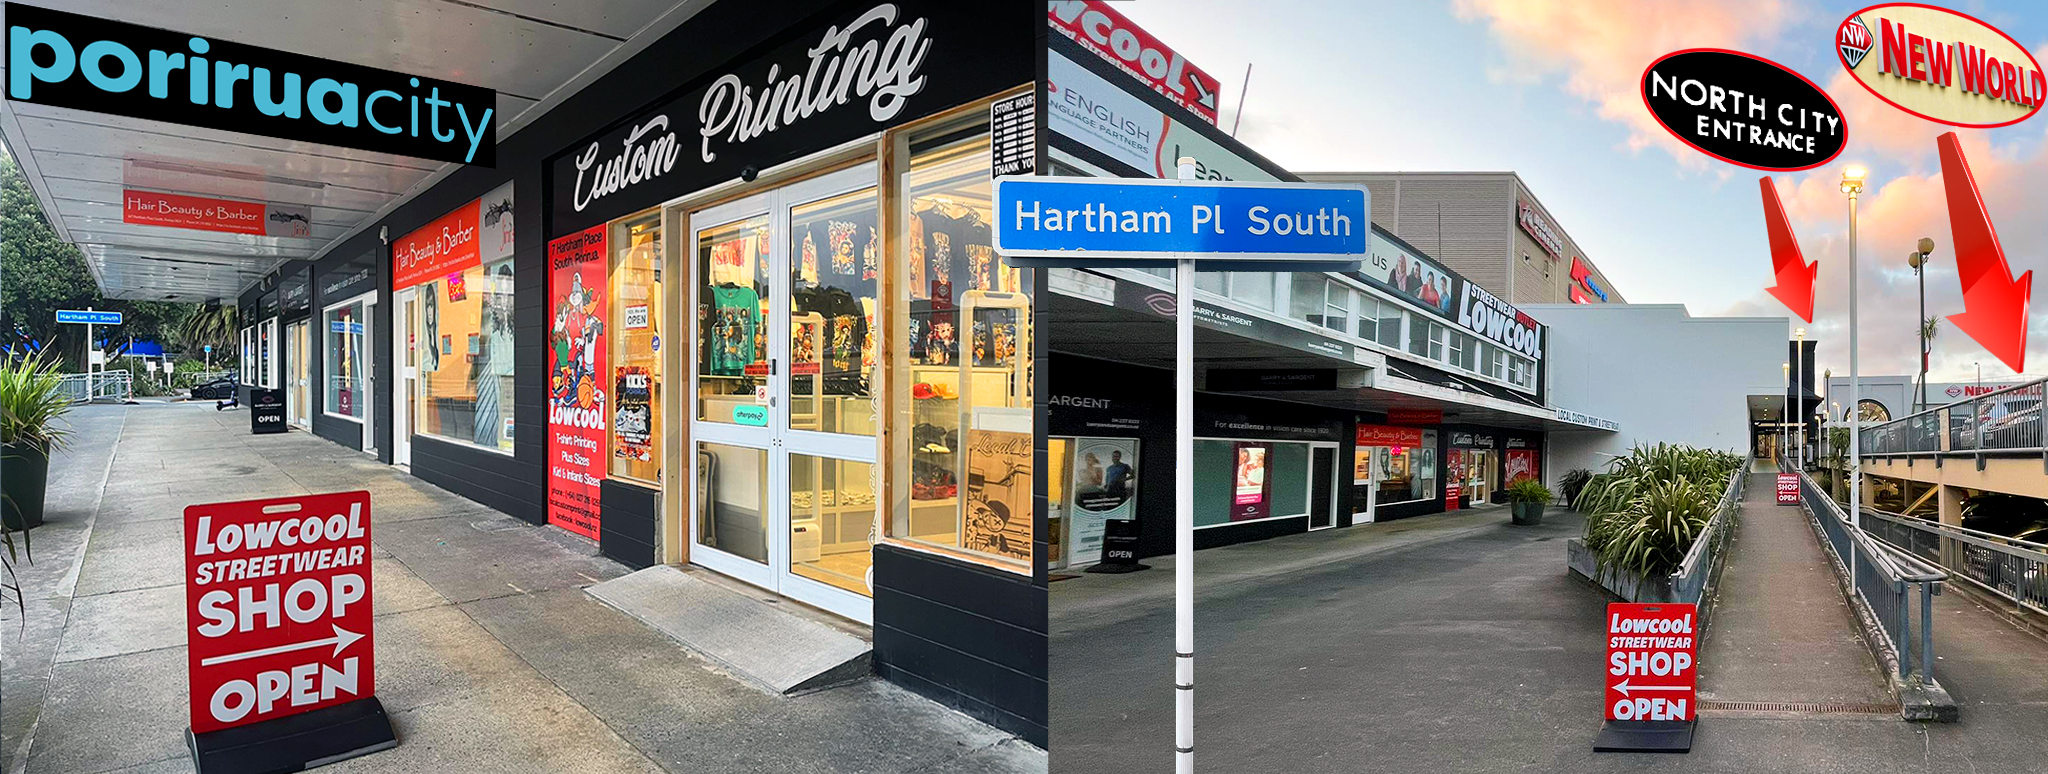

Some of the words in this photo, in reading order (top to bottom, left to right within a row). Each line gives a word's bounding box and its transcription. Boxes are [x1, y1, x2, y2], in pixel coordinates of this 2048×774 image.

[1078, 37, 1153, 87] Streetwear
[1155, 84, 1164, 94] &
[1166, 91, 1184, 107] Art
[1187, 103, 1215, 124] Store
[573, 114, 683, 212] Custom
[700, 3, 933, 163] Printing
[994, 100, 1014, 115] STORE
[1064, 87, 1150, 143] ENGLISH
[1048, 100, 1096, 128] NGUAGE
[1100, 122, 1149, 154] PARTNERS
[994, 161, 1019, 176] THANK
[128, 197, 155, 211] Hair
[158, 200, 202, 219] Beauty
[205, 206, 215, 216] &
[217, 206, 258, 221] Barber
[1015, 200, 1171, 235] Hartham
[1192, 205, 1224, 234] Pl
[1247, 206, 1351, 237] South
[396, 248, 409, 273] Hair
[410, 242, 435, 268] Beauty
[436, 236, 442, 254] &
[442, 219, 474, 255] Barber
[551, 244, 556, 256] 7
[557, 238, 583, 254] Hartham
[583, 231, 603, 246] Place
[1372, 252, 1387, 271] us
[1471, 283, 1516, 320] STREETWEAR
[1516, 311, 1536, 329] OUTLET
[627, 314, 646, 325] OPEN
[1193, 315, 1228, 327] PTOMETRISTS
[1221, 313, 1253, 327] SARGENT
[1048, 394, 1111, 409] ARGENT
[1964, 386, 1993, 397] NEW
[258, 415, 280, 423] OPEN
[1228, 422, 1264, 430] excellence
[1273, 423, 1289, 432] vision
[1558, 409, 1571, 421] LOCAL
[1572, 412, 1588, 424] CUSTOM
[1588, 416, 1598, 427] PRINT
[556, 432, 573, 446] T-shirt
[573, 434, 597, 453] Printing
[1359, 427, 1373, 438] Hair
[1373, 428, 1394, 440] Beauty
[1401, 430, 1418, 440] Barber
[971, 432, 1018, 458] Local
[561, 450, 573, 463] Plus
[573, 453, 590, 467] Sizes
[553, 466, 561, 477] Kid
[584, 473, 601, 488] Sizes
[195, 544, 364, 585] STREETWEAR
[1109, 550, 1133, 558] OPEN
[197, 573, 366, 638] SHOP
[1610, 636, 1692, 648] STREETWEAR
[1609, 651, 1692, 676] SHOP
[209, 657, 358, 722] OPEN
[1613, 698, 1687, 721] OPEN
